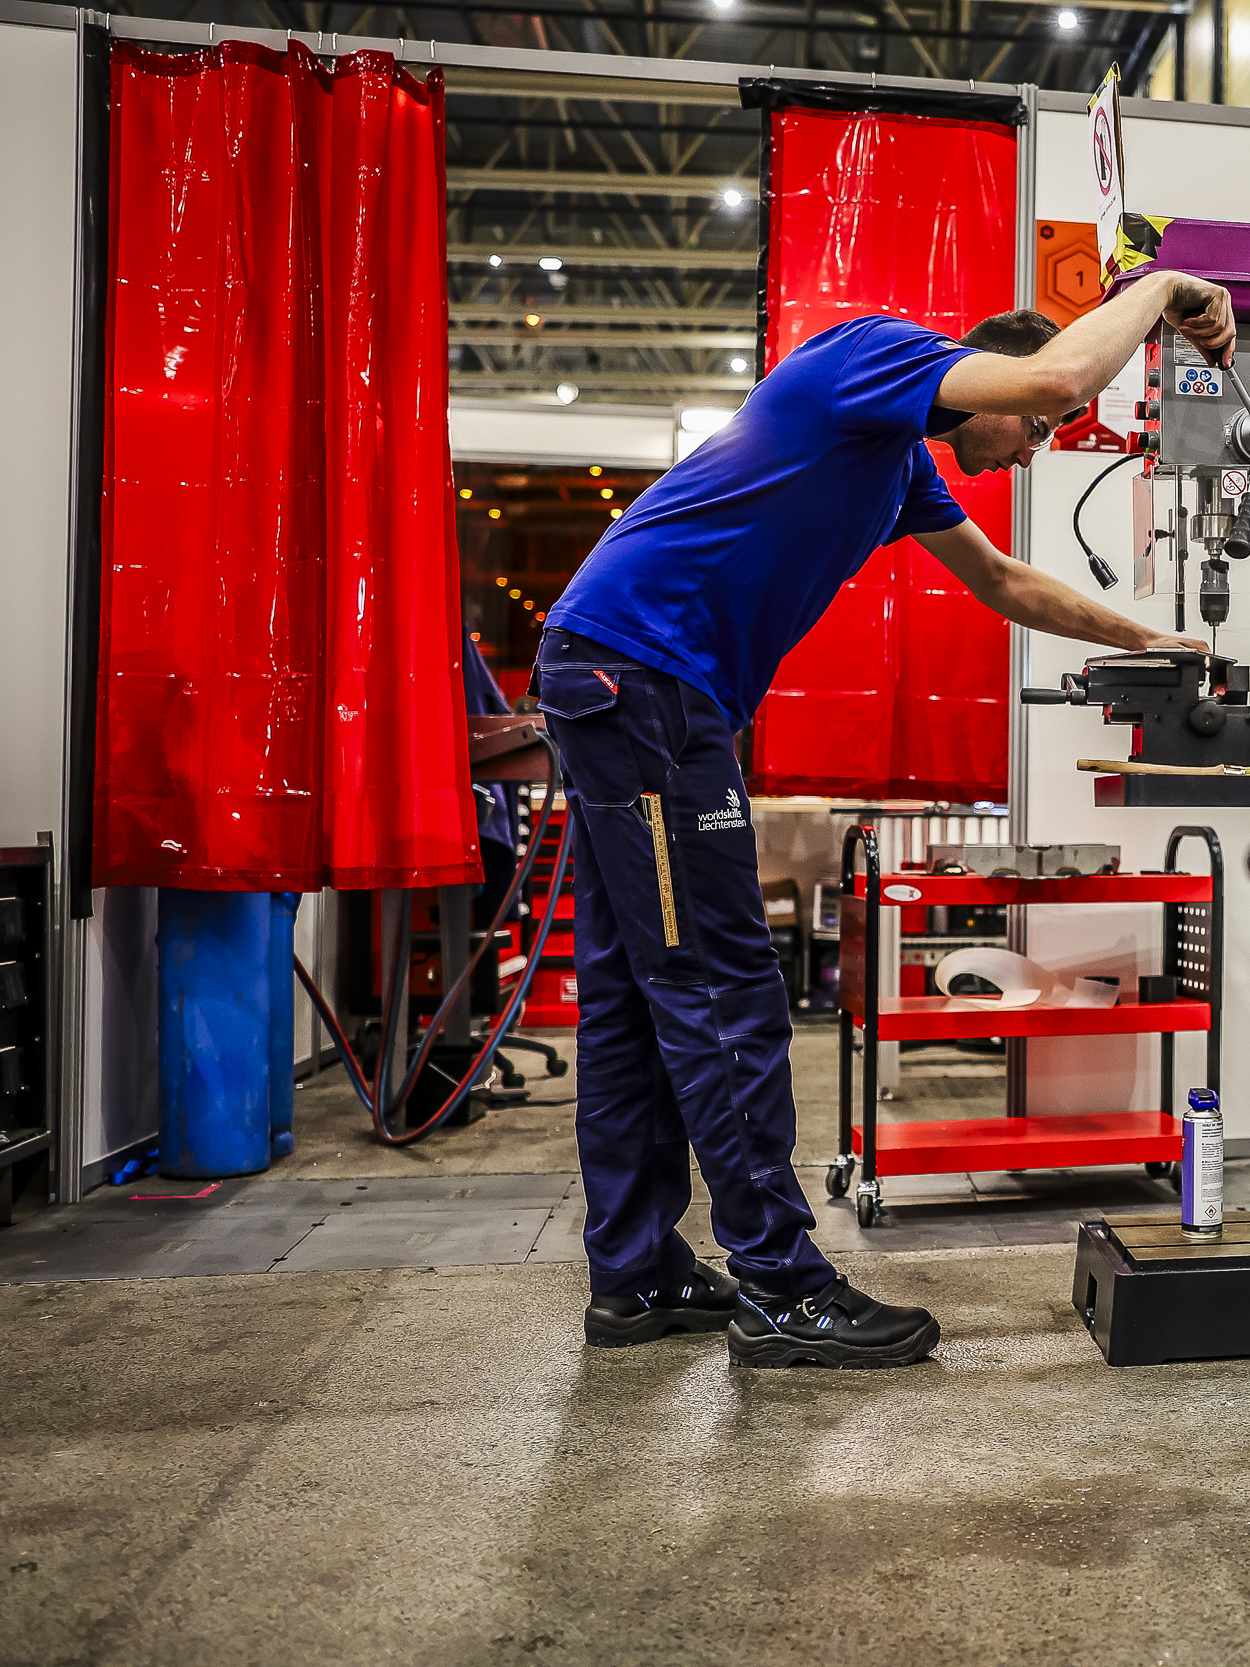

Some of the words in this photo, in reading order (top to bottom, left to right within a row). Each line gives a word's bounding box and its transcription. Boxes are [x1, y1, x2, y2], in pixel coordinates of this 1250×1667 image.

[1075, 270, 1084, 287] 1
[698, 808, 742, 821] worldskills
[698, 819, 747, 831] Liechtenstein
